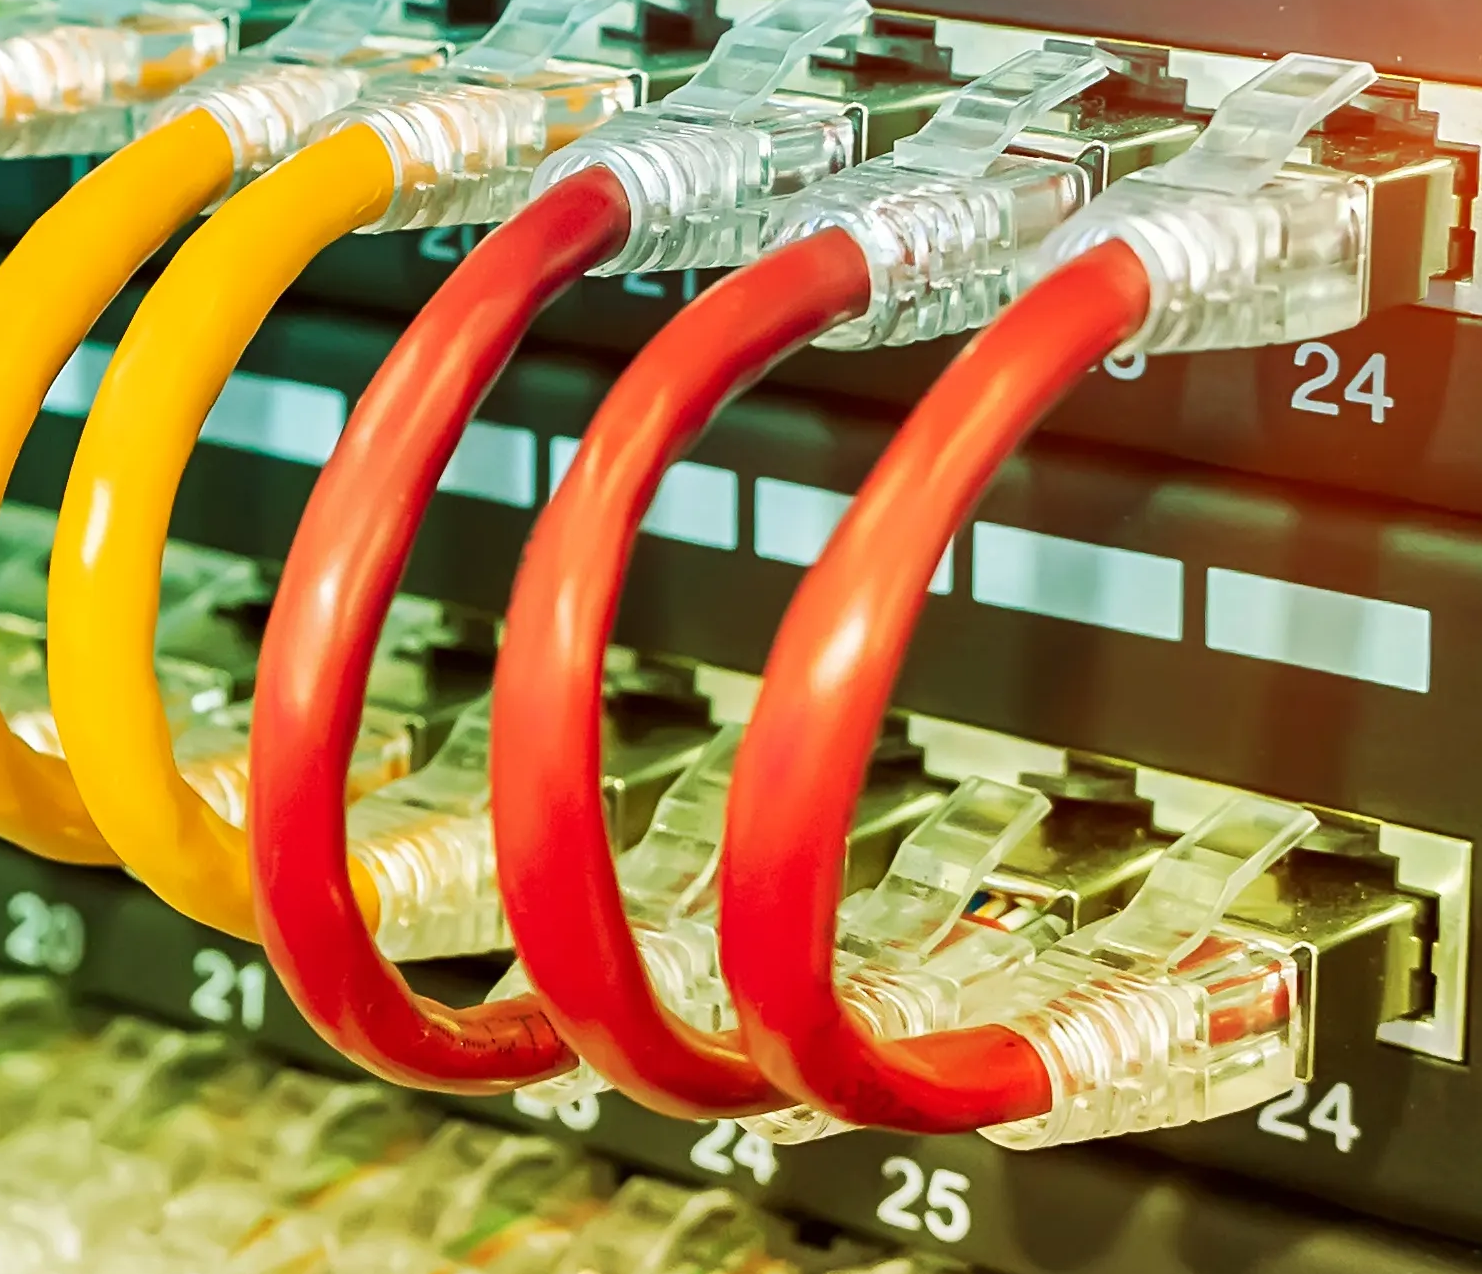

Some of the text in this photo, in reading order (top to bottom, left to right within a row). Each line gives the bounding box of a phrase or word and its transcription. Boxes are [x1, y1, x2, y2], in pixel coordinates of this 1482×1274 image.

[1290, 341, 1395, 424] 24
[188, 947, 266, 1031] 21
[690, 1119, 779, 1186] 24
[876, 1156, 972, 1243] 25
[1256, 1080, 1362, 1154] 24
